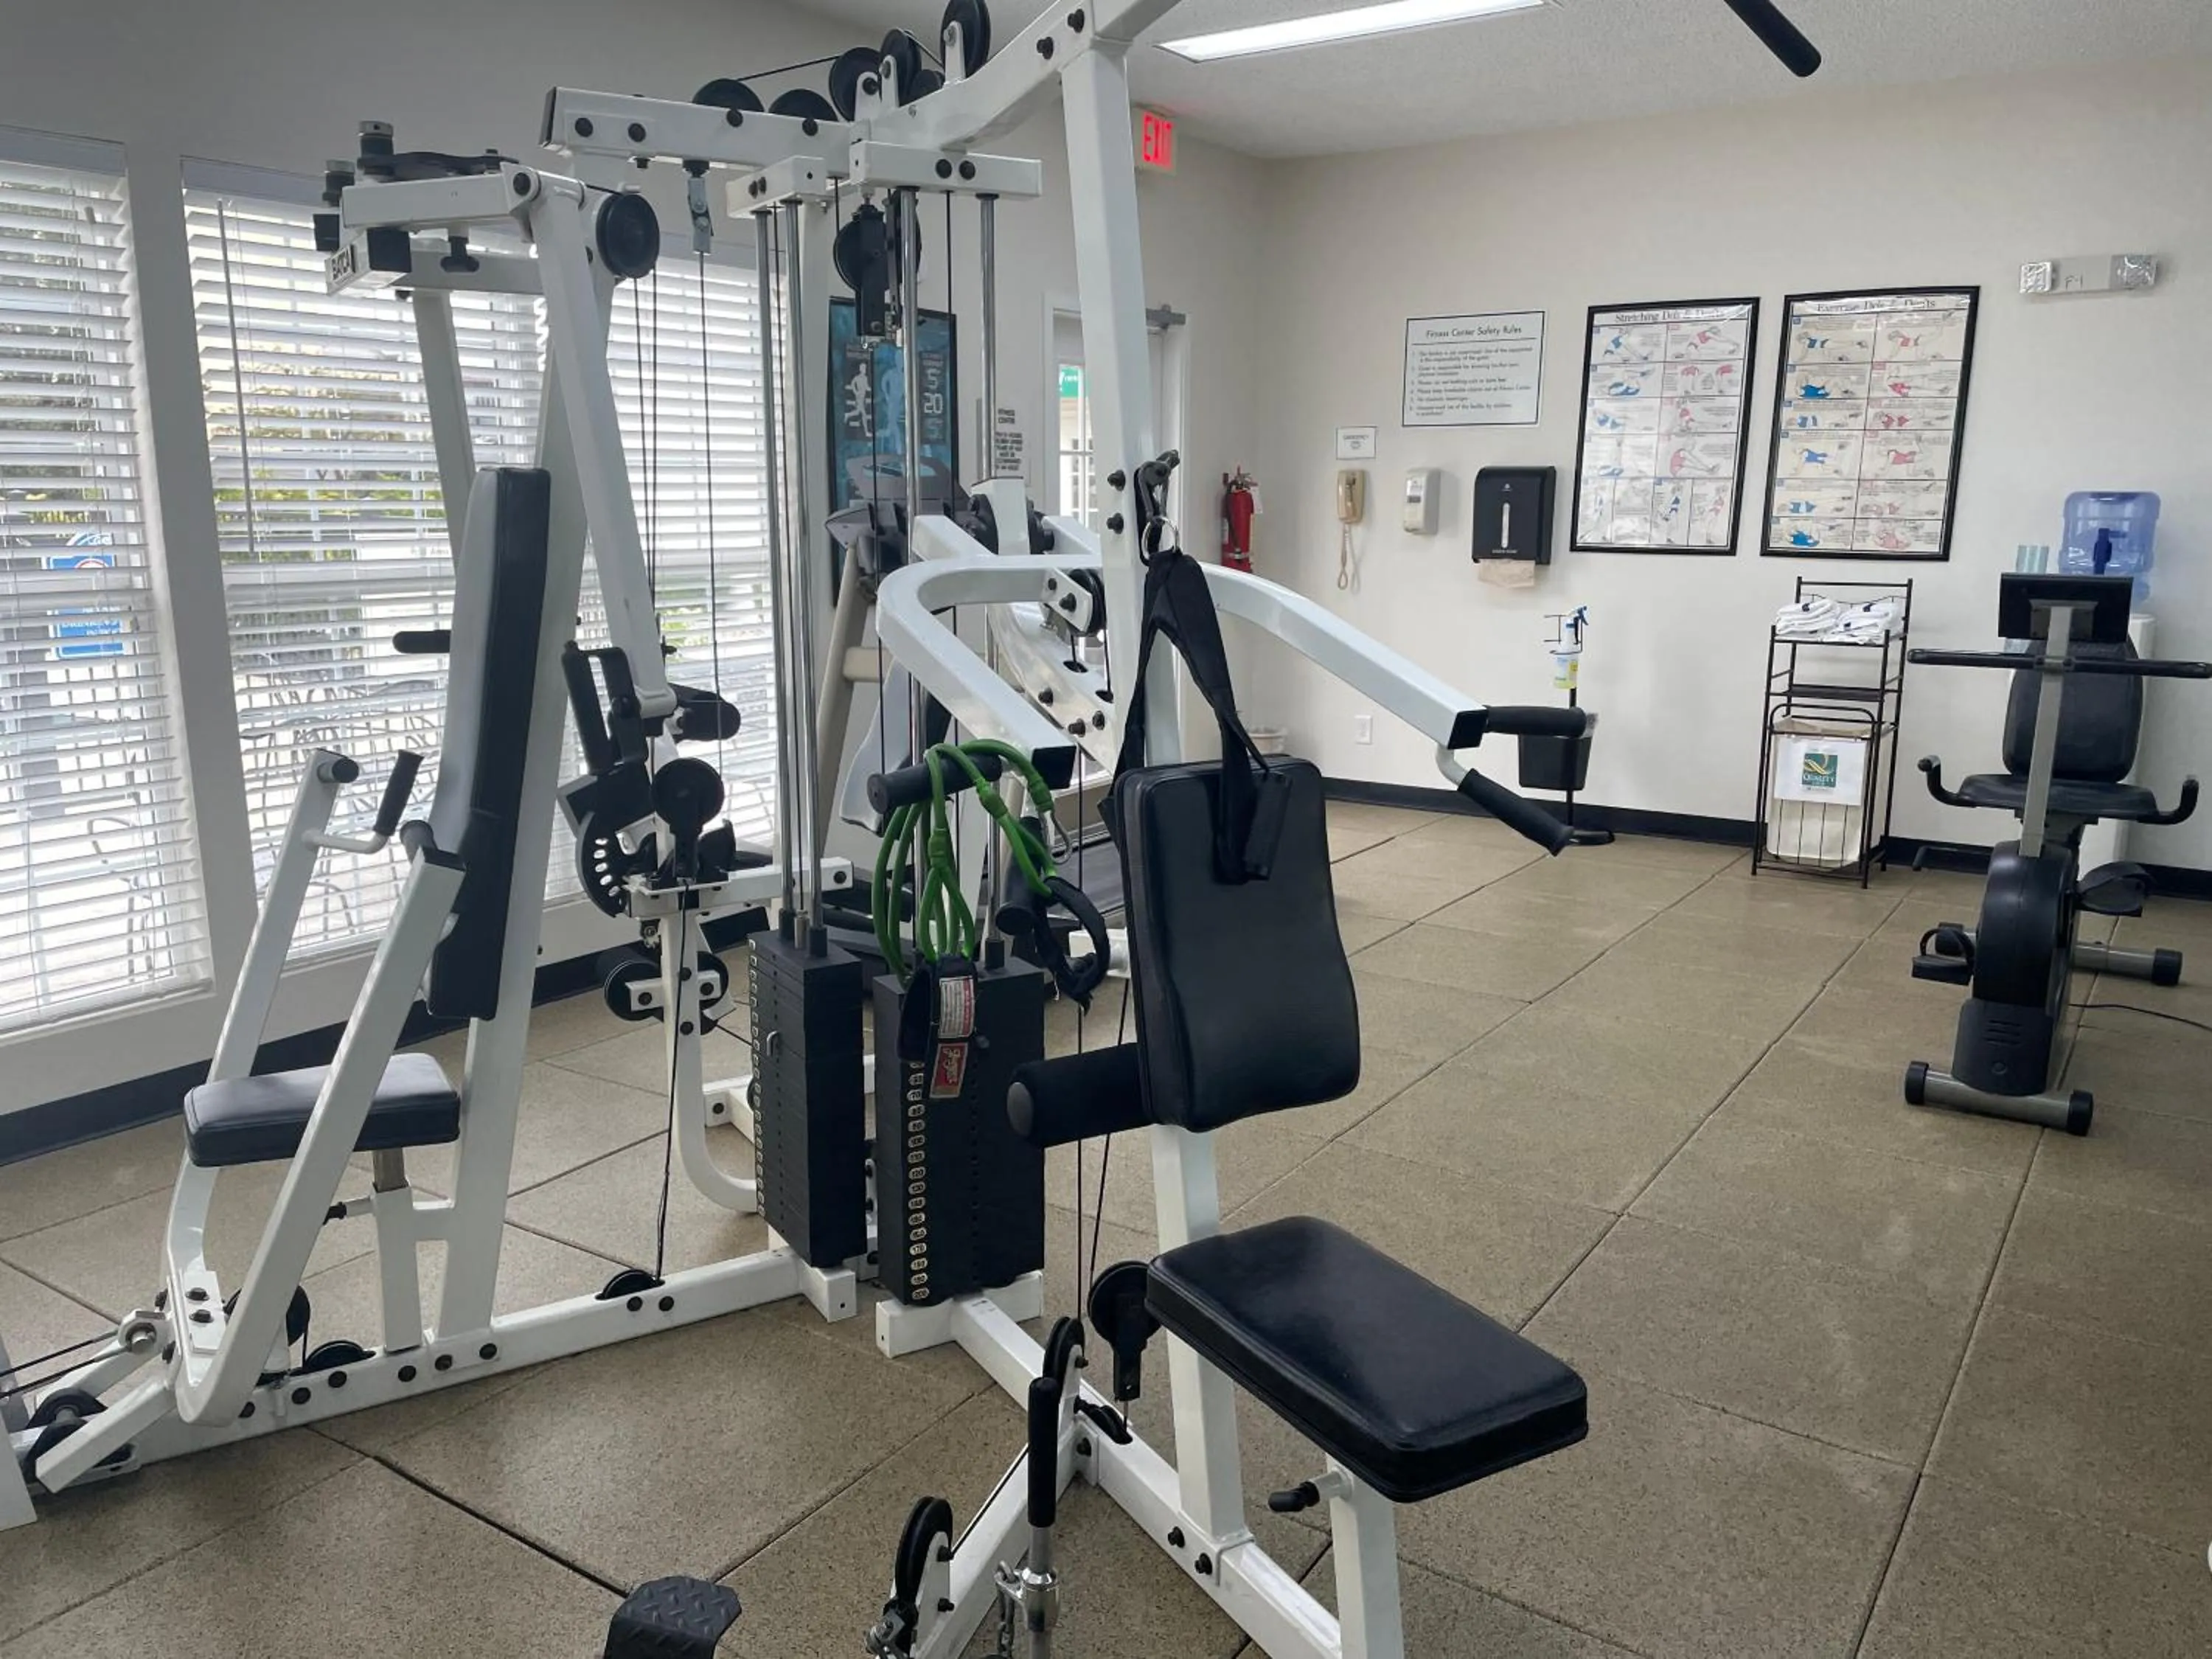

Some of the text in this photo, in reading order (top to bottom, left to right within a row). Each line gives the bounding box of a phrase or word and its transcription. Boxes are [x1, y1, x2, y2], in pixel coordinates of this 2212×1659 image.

[1144, 112, 1173, 170] EXIT
[1425, 324, 1523, 338] Fitness Center Safety Rules
[923, 393, 943, 414] 20
